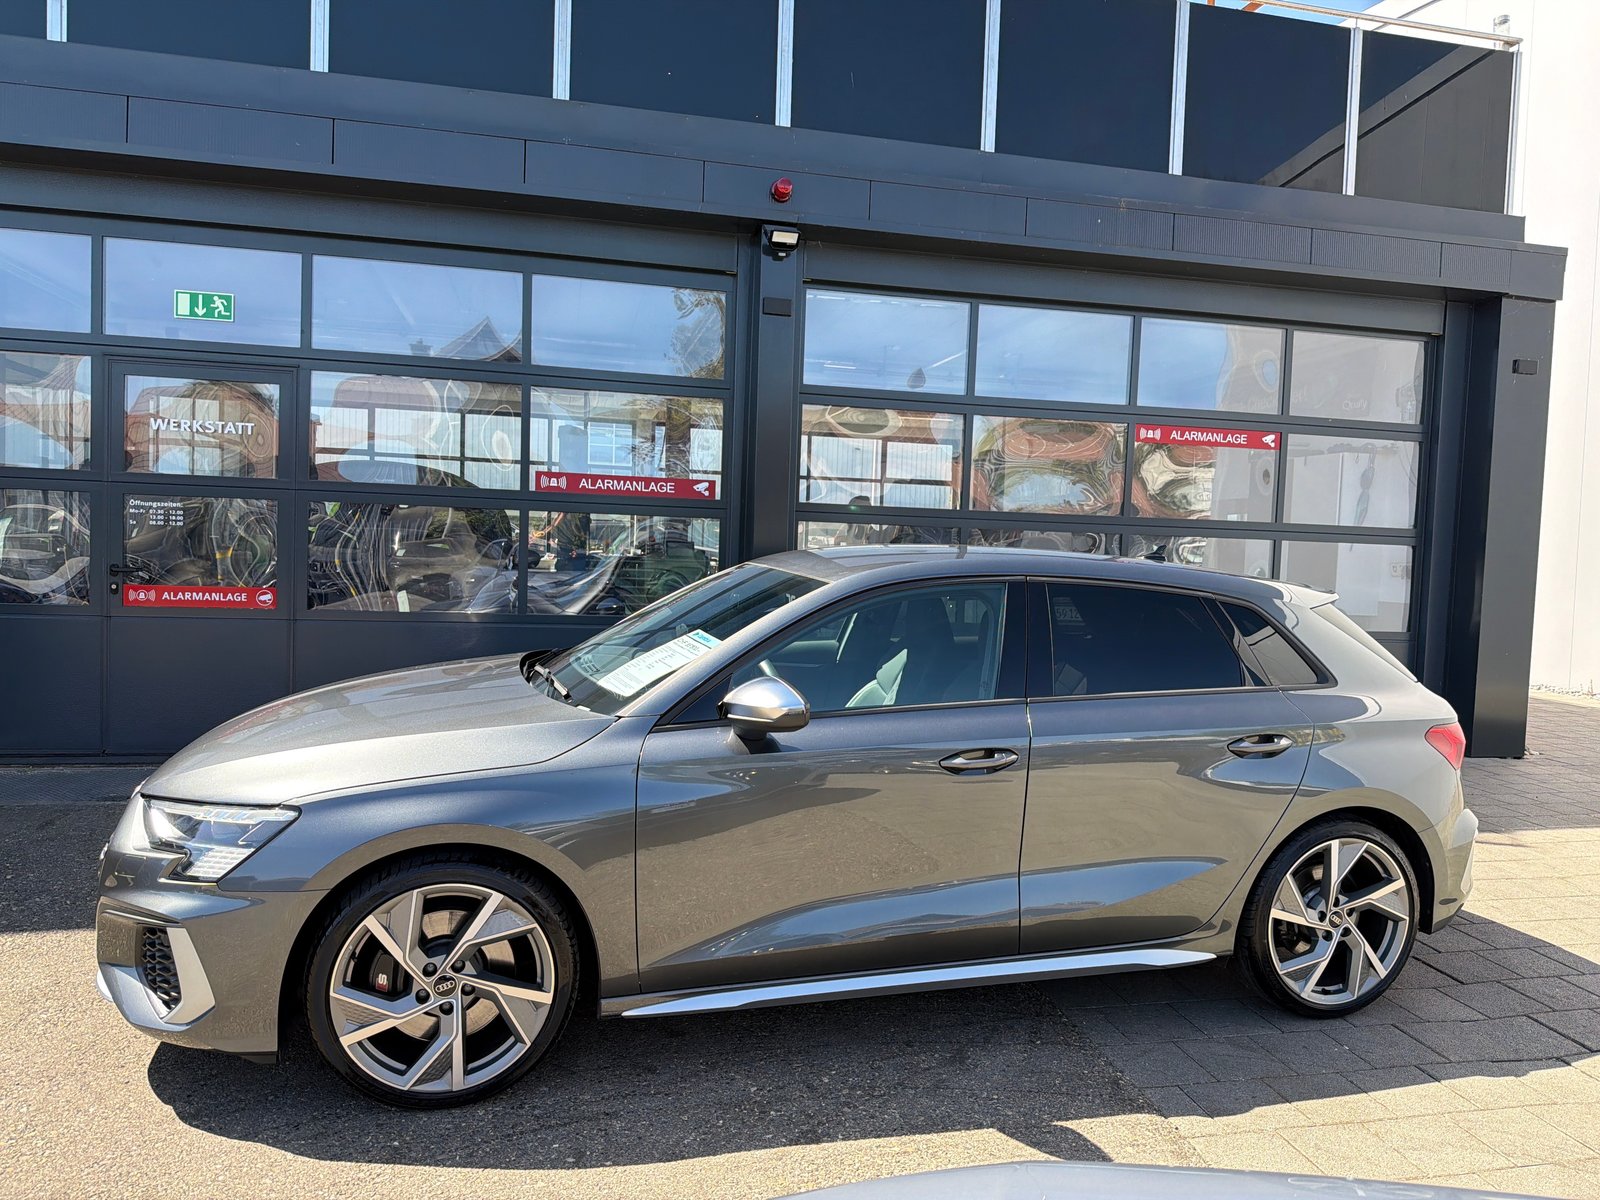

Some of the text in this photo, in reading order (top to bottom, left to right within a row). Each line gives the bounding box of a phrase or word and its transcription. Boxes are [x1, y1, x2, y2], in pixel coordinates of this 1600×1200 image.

[150, 418, 255, 434] WERKSTATT
[1170, 430, 1247, 444] ALARMANLAGE
[579, 478, 675, 493] ALARMANLAGE
[162, 592, 247, 602] ALARMANLAGE
